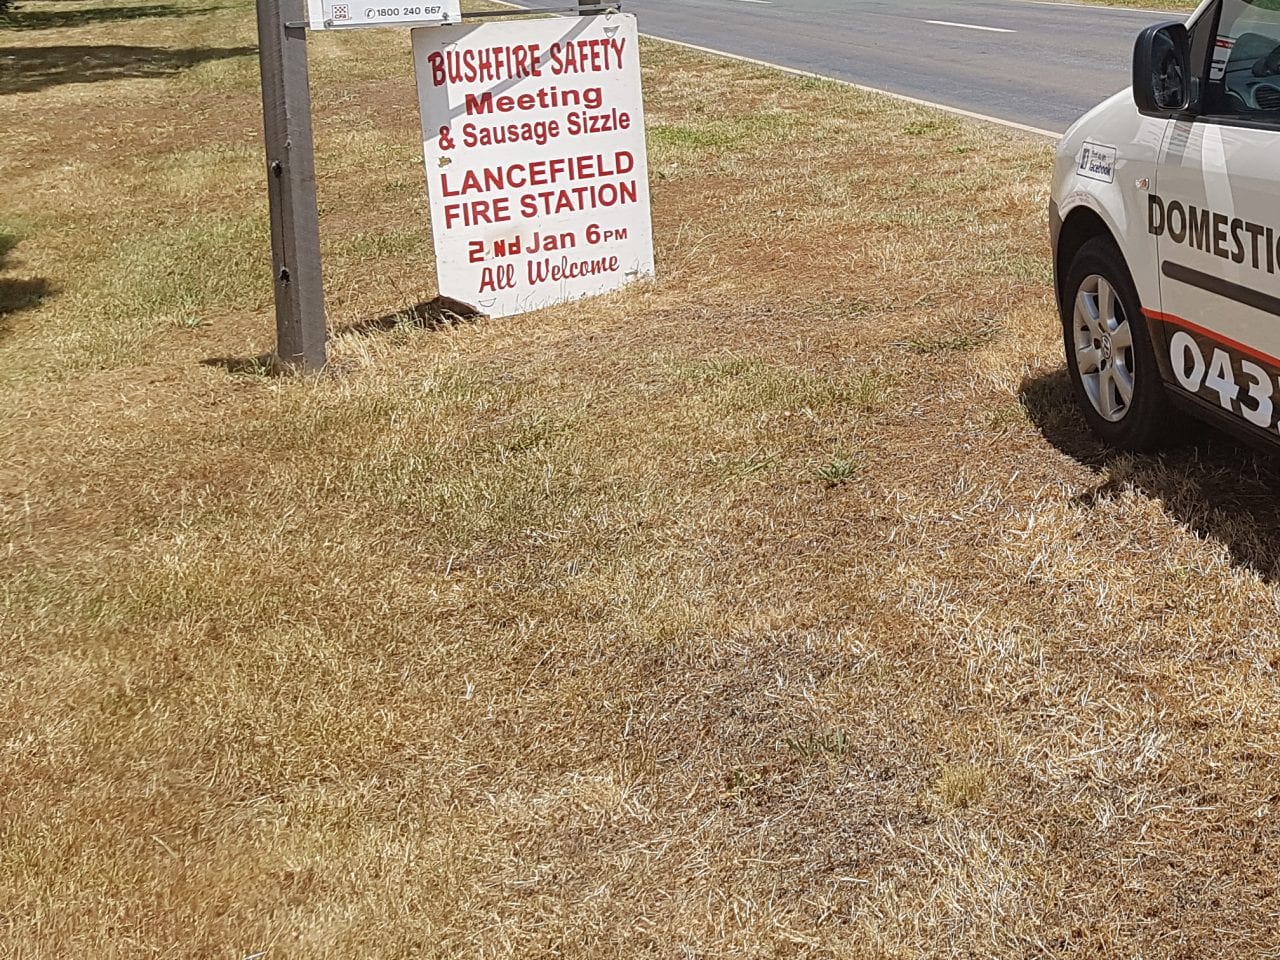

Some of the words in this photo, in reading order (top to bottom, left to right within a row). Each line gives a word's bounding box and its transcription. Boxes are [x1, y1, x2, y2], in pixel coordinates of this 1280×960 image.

[376, 7, 400, 17] 1800
[403, 7, 421, 16] 240
[424, 6, 441, 15] 667
[427, 42, 543, 87] BUSHFIRE
[549, 37, 626, 76] SAFETY
[464, 85, 603, 117] Meeting
[438, 125, 456, 151] &
[463, 117, 560, 149] Sausage
[567, 108, 631, 136] Sizzle
[440, 150, 634, 197] LANCEFIELD
[444, 197, 511, 230] FIRE
[520, 180, 638, 218] STATION
[525, 230, 576, 254] Jan
[478, 263, 517, 293] All
[527, 255, 621, 286] Welcome
